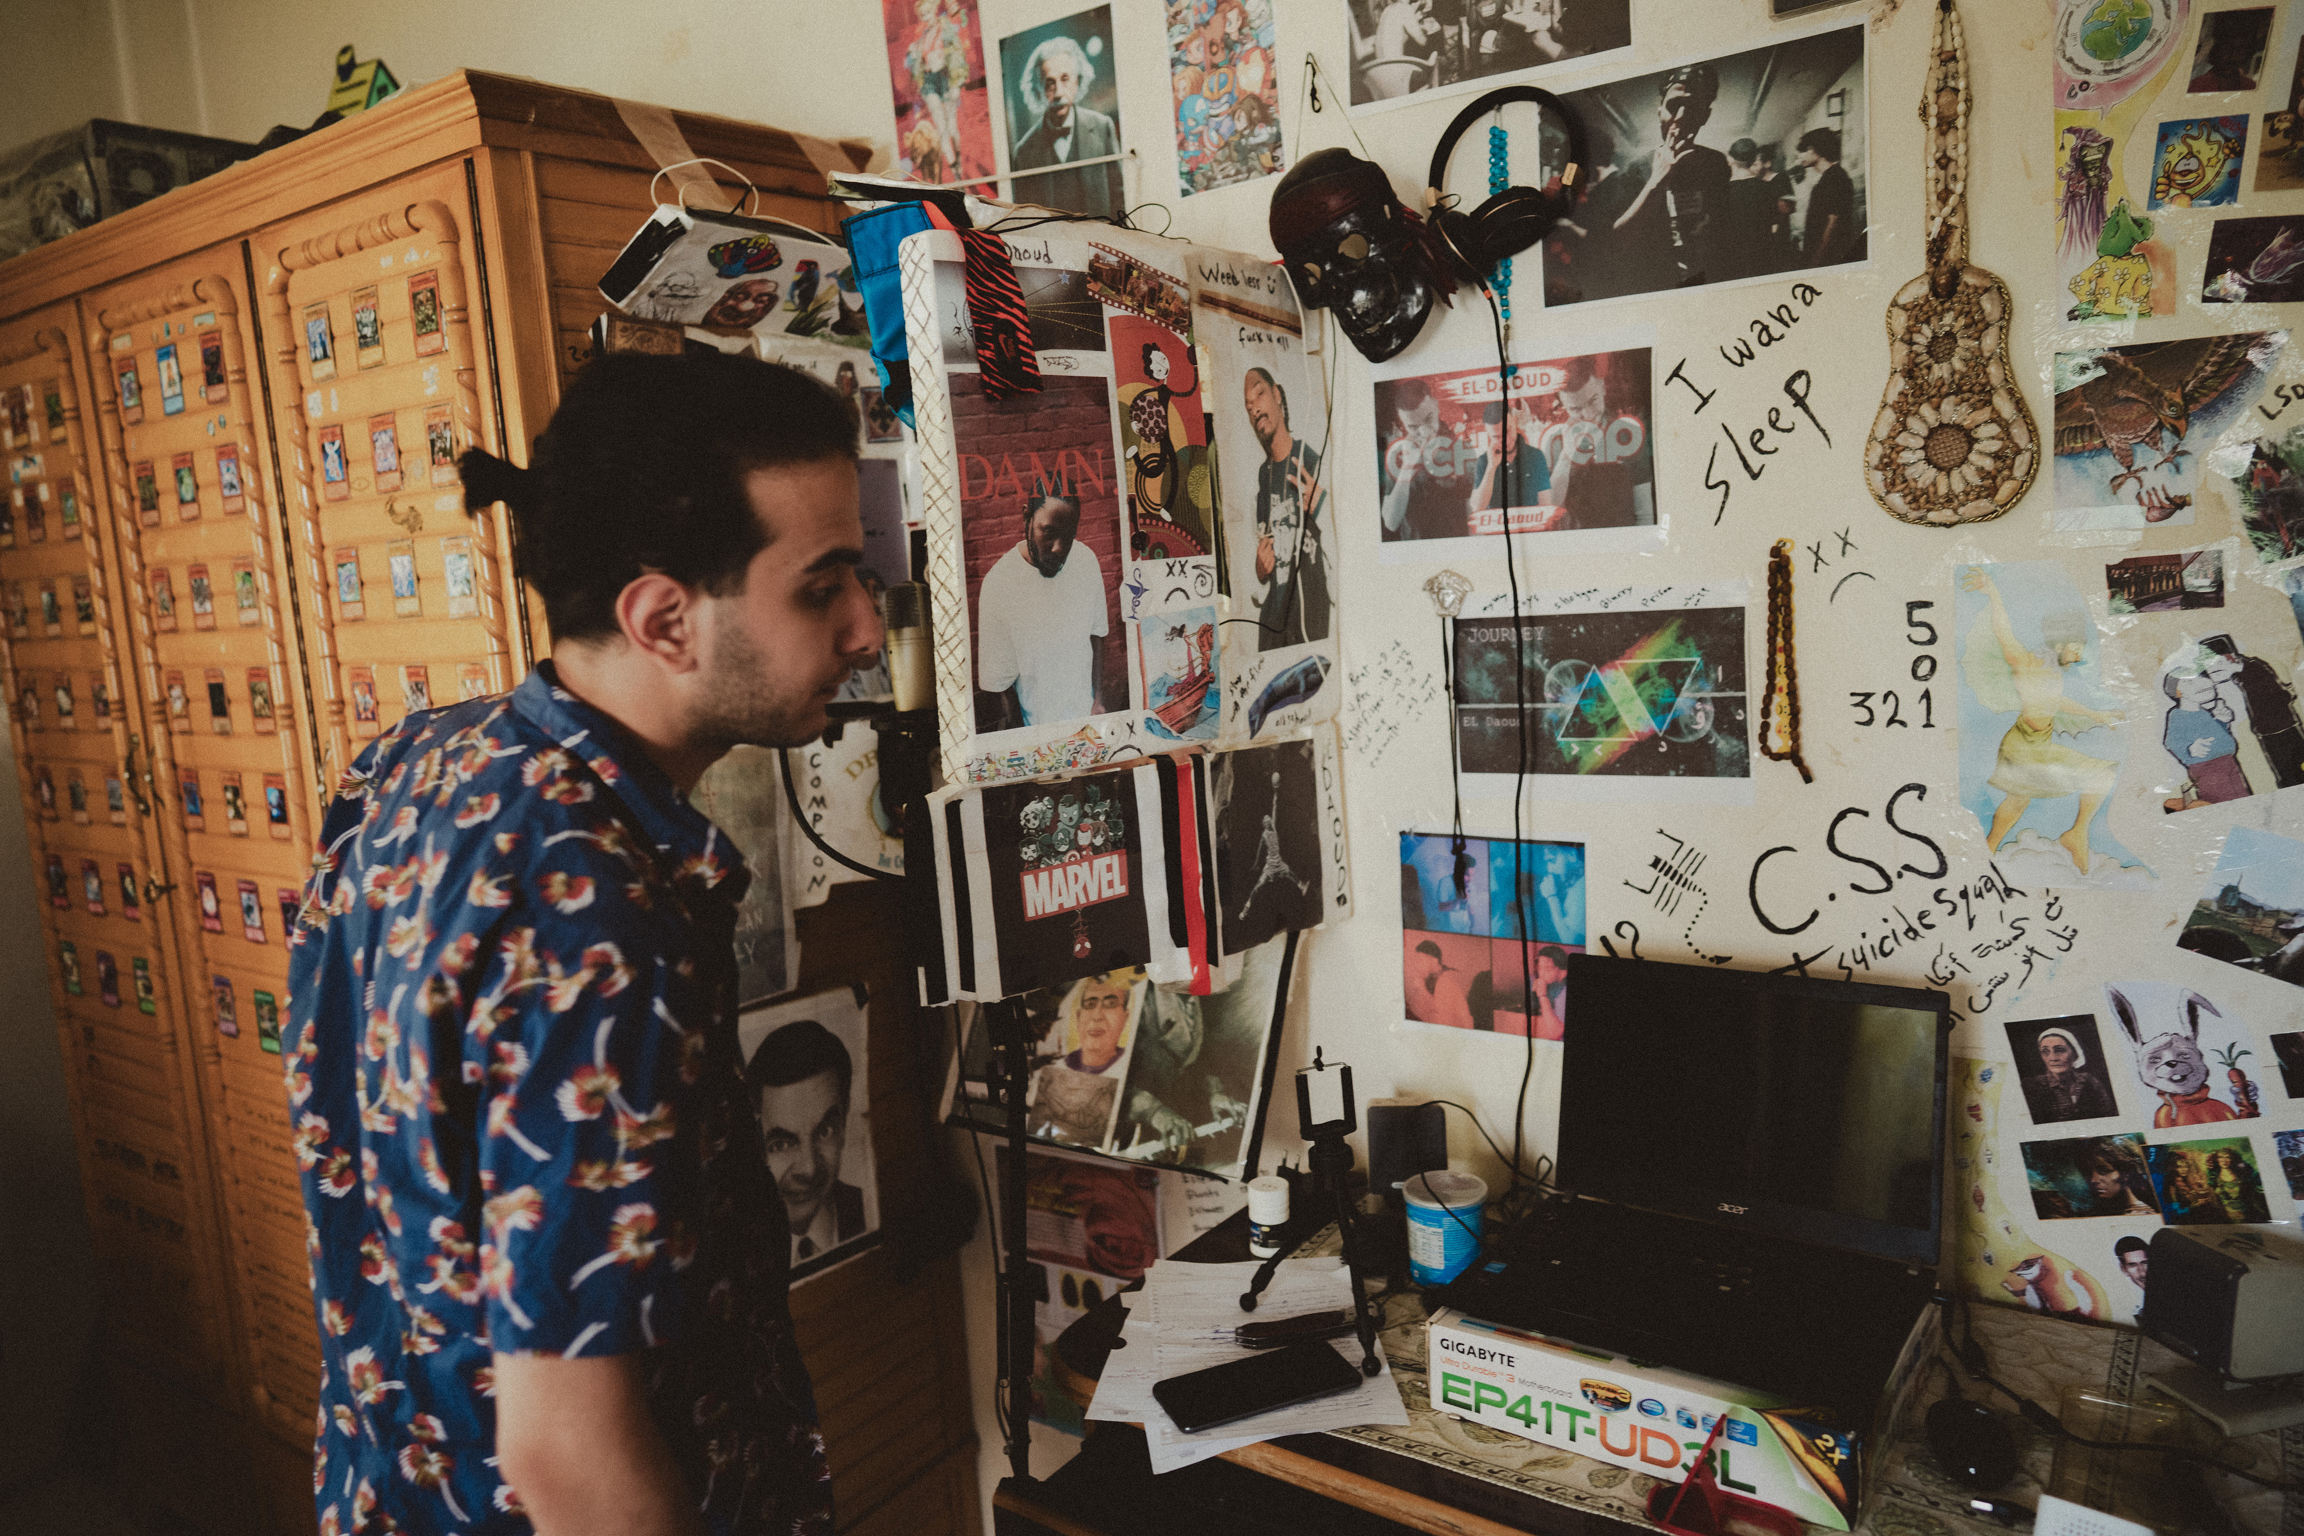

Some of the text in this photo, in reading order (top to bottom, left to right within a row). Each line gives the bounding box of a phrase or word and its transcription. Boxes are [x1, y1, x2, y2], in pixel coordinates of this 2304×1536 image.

[1199, 262, 1240, 286] Weed
[1665, 283, 1823, 414] I wana
[2258, 383, 2304, 420] LSD
[957, 449, 1119, 500] DAMN.
[1906, 600, 1938, 646] 5
[808, 752, 828, 893] COMPON
[1022, 854, 1127, 918] MARVEL
[1717, 1202, 1749, 1215] acer
[1440, 1338, 1516, 1368] GIGABYTE
[1440, 1355, 1460, 1370] Ultra
[1506, 1373, 1516, 1383] 3
[1518, 1377, 1573, 1400] Motherboard
[1442, 1371, 1757, 1495] EP41T-UD3L
[1814, 1433, 1848, 1466] 2X
